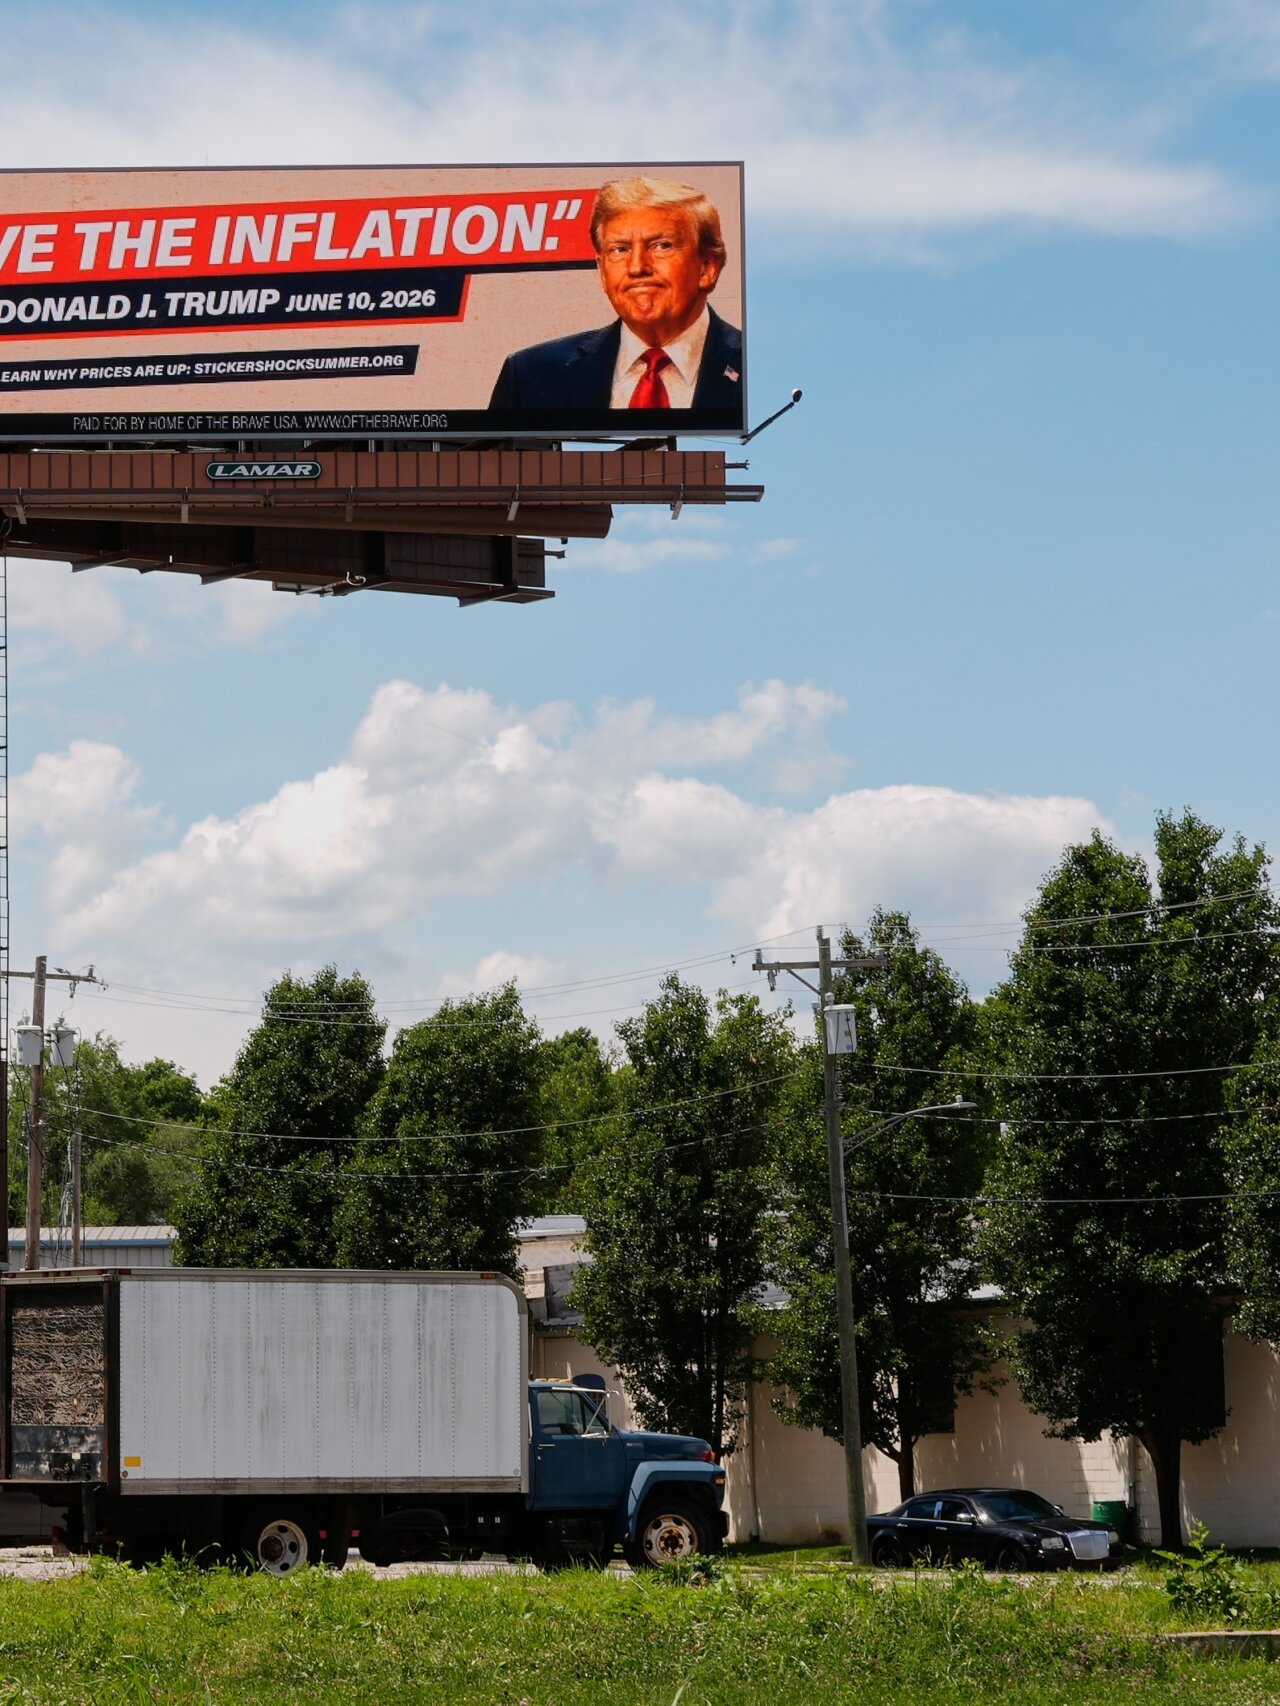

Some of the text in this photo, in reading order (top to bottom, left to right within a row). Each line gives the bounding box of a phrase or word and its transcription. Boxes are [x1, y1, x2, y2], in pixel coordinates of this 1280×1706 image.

[74, 217, 196, 271] THE
[135, 293, 157, 319] J.
[164, 288, 281, 317] TRUMP
[285, 293, 342, 313] JUNE
[347, 292, 375, 312] 10,
[376, 289, 437, 309] 2026
[44, 367, 78, 381] WHY
[79, 365, 133, 380] PRICES
[134, 364, 164, 377] ARE
[166, 362, 191, 376] UP:
[194, 355, 404, 374] STICKERSHOCKSUMMER.ORG
[73, 416, 100, 430] PAID
[103, 416, 127, 430] FOR
[131, 416, 146, 430] BY
[148, 416, 185, 430] HOME
[187, 416, 203, 430] OF
[206, 415, 229, 429] THE
[232, 415, 270, 429] BRAVE
[304, 414, 448, 428] WWW.OFTHEBRAVE.ORG
[214, 464, 313, 477] LAMAR
